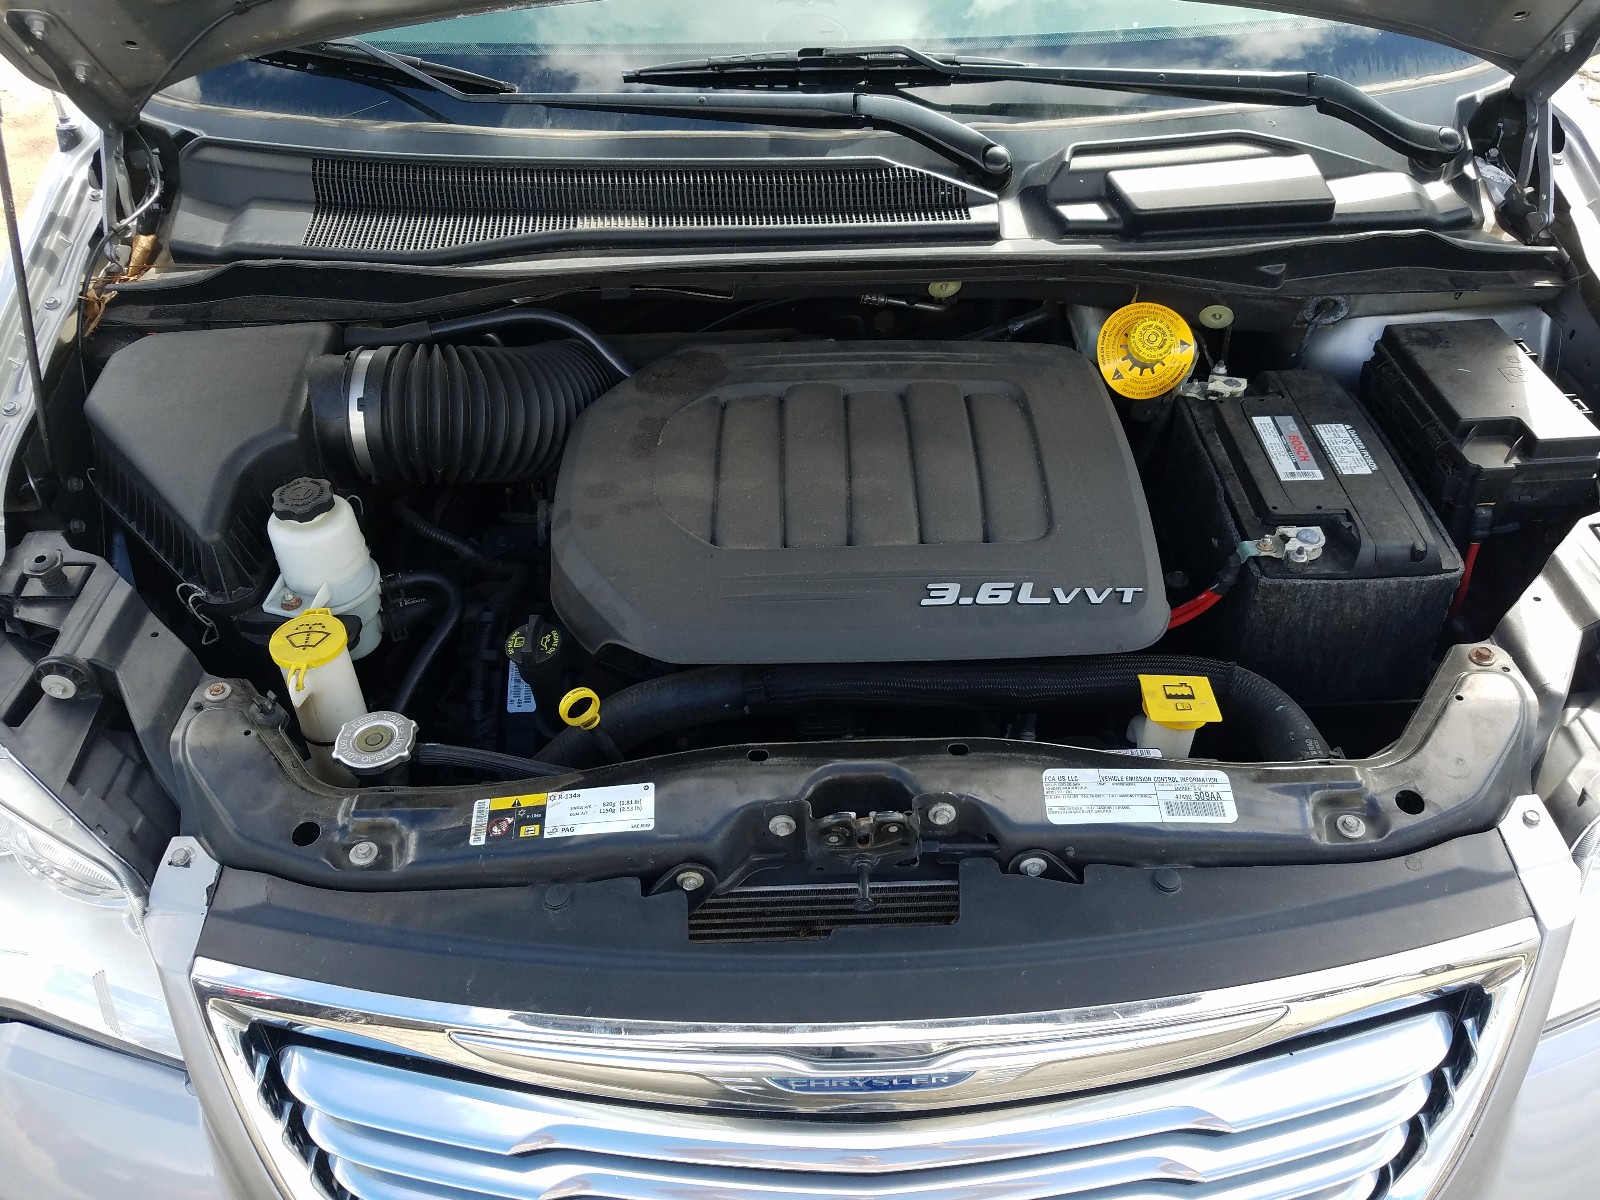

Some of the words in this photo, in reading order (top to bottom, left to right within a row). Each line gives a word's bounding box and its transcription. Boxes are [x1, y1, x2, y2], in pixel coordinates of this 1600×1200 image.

[1288, 435, 1310, 462] BOSCH
[1193, 791, 1222, 801] 509AA
[788, 1076, 949, 1089] CHRYSLER
